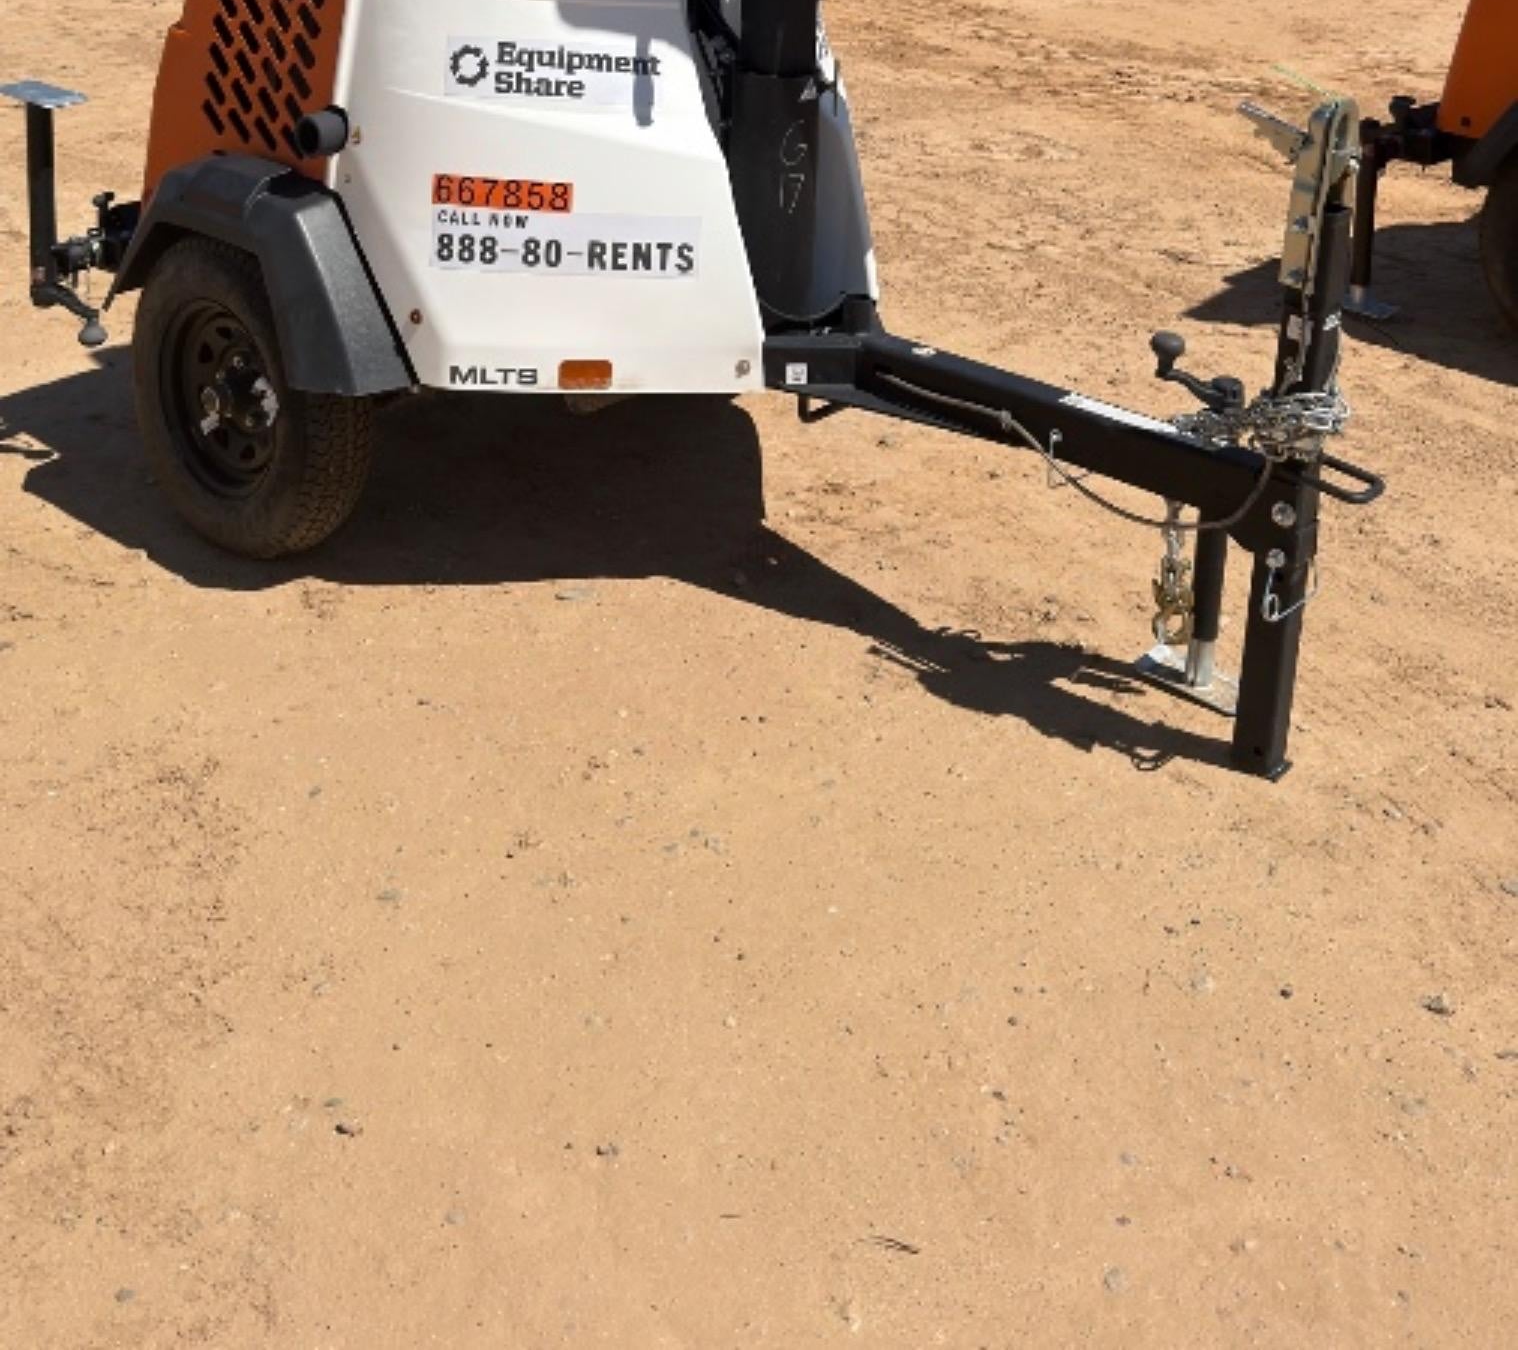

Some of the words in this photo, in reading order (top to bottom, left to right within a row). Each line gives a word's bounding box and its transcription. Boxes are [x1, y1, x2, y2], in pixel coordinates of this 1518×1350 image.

[495, 41, 661, 76] Equipment
[494, 71, 585, 98] Share
[434, 174, 570, 211] 667858
[438, 210, 481, 226] CALL
[437, 233, 694, 274] 888-80-RENTS
